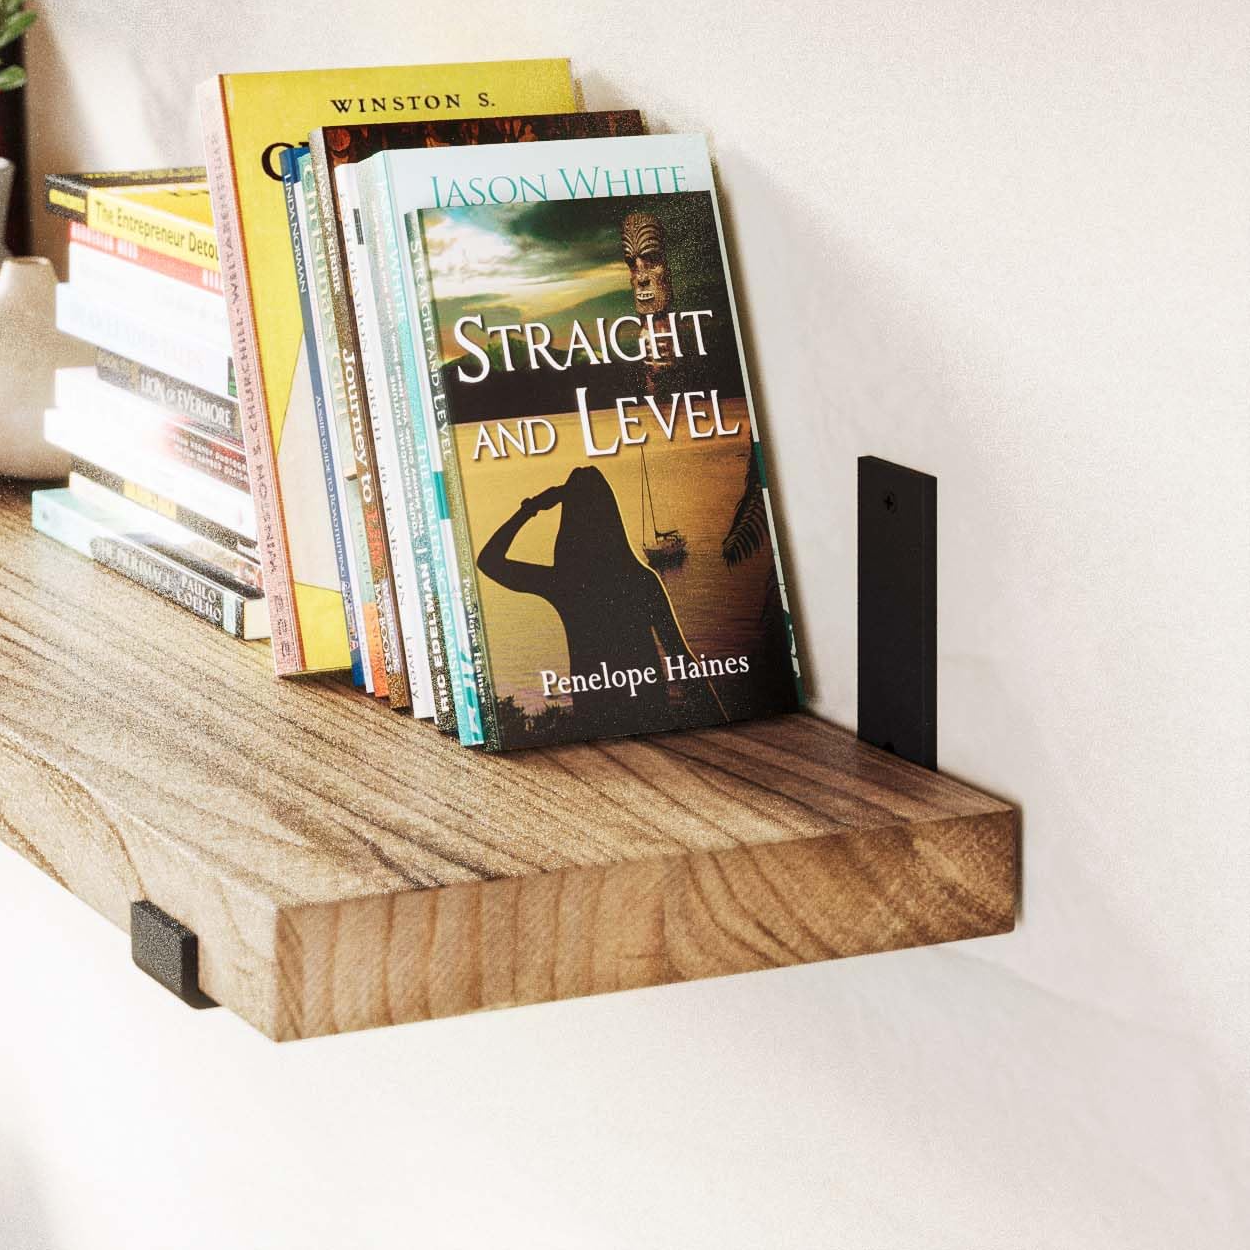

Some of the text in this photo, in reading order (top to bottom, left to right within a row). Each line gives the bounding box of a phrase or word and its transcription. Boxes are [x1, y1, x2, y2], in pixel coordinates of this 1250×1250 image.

[330, 92, 496, 114] WINSTON S.
[430, 165, 691, 208] JASON WHITE
[117, 208, 186, 248] Entrepreneur
[188, 231, 219, 262] Detou
[282, 172, 308, 293] LINDA NORMAN
[408, 238, 455, 460] STRAIGHT AND LEVEL
[453, 309, 713, 383] STRAIGHT
[338, 346, 371, 467] Journey
[359, 472, 375, 504] to
[472, 386, 740, 460] AND LEVEL
[180, 573, 217, 602] PAULO
[419, 562, 449, 712] RIC EDELMAN
[432, 566, 468, 708] SCHOLARSHIP
[459, 577, 489, 704] Penelope Haines
[540, 654, 750, 697] Penelope Haines
